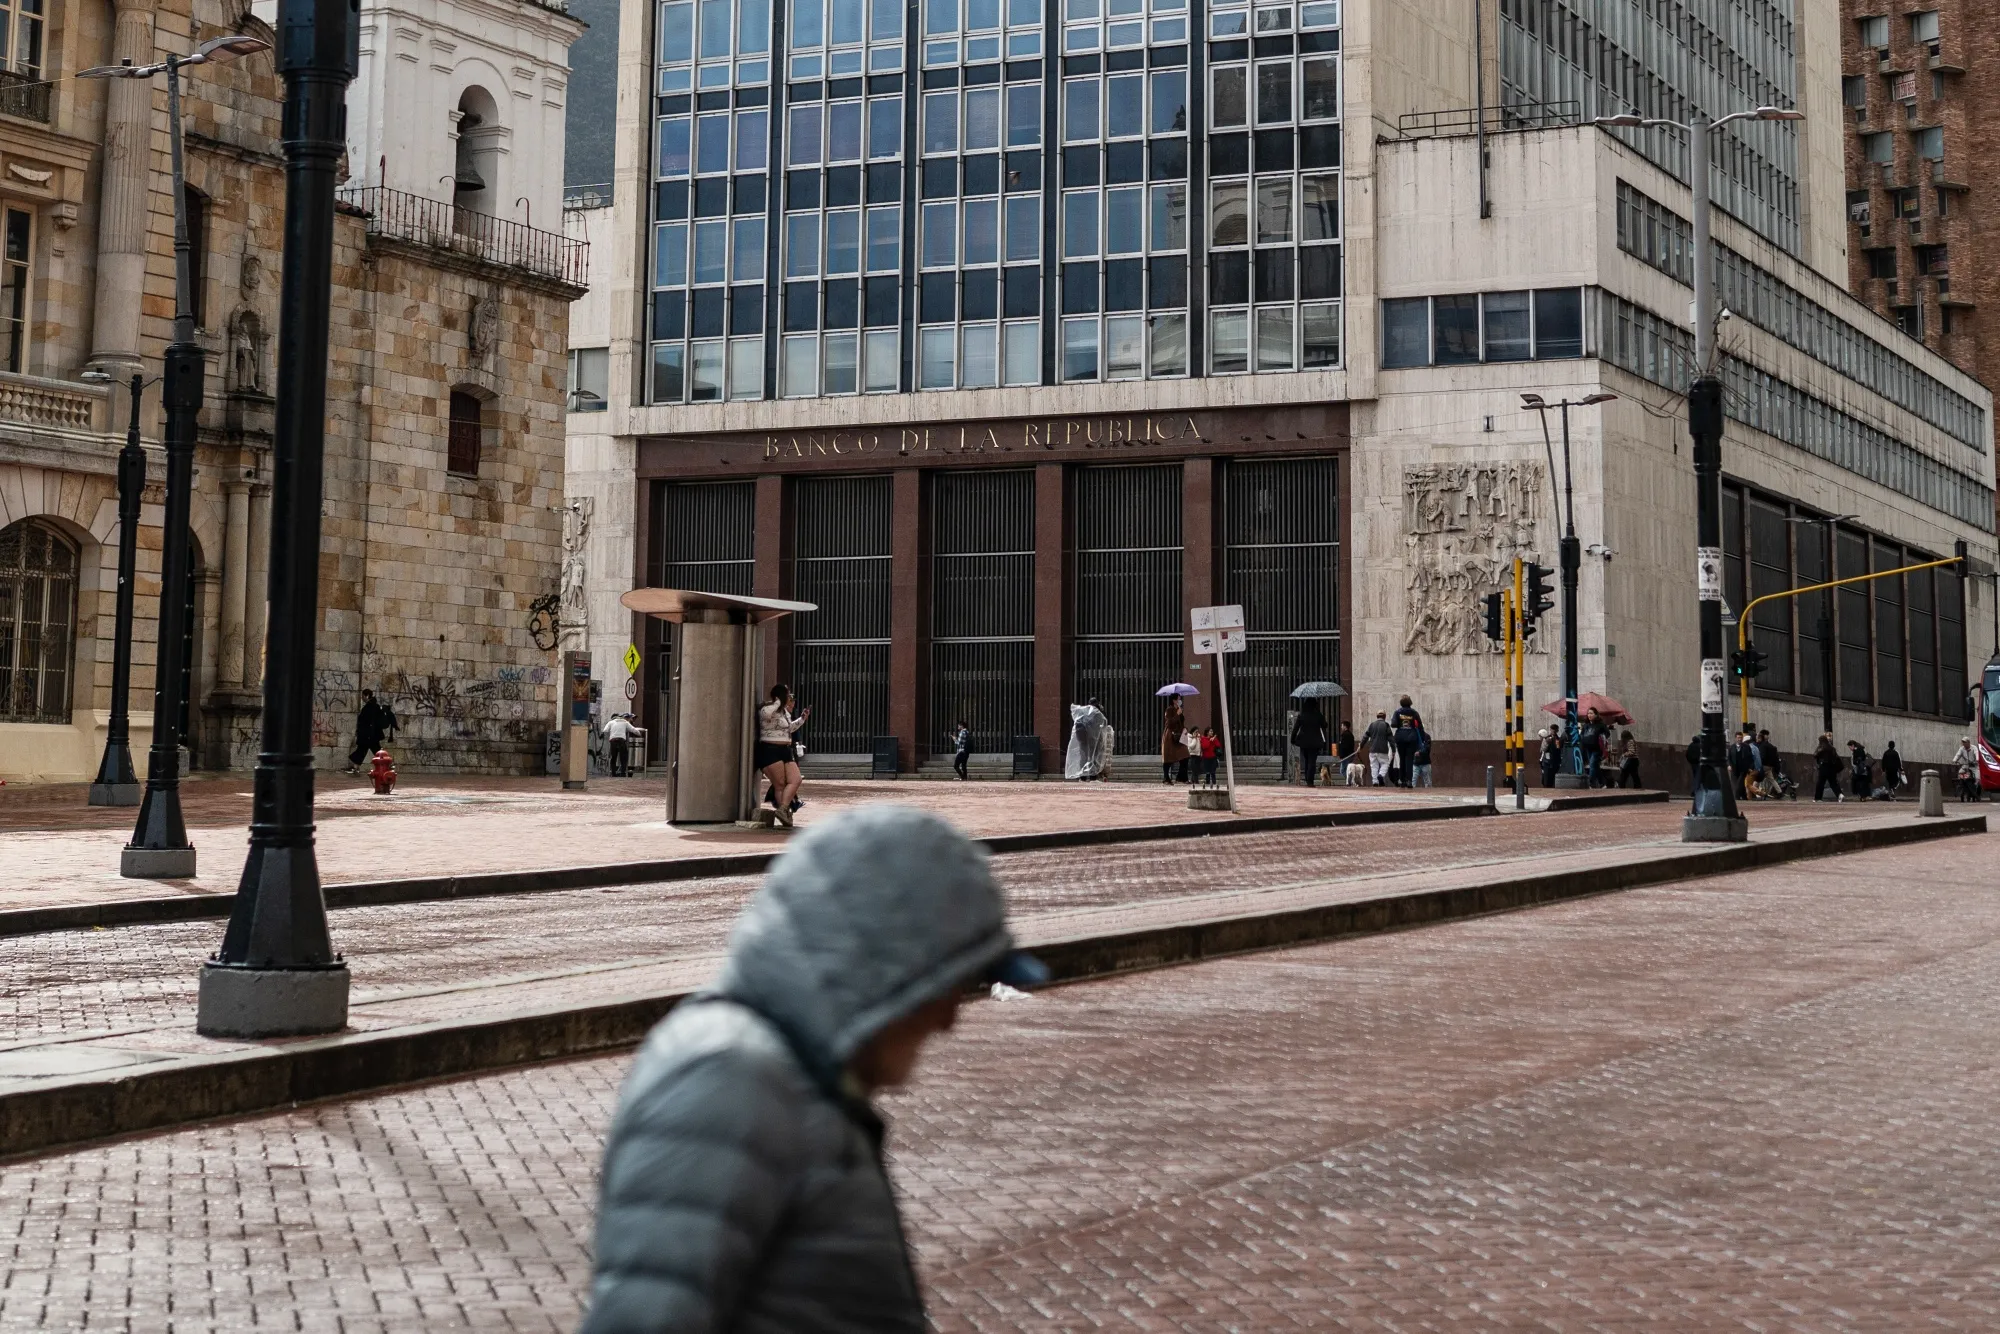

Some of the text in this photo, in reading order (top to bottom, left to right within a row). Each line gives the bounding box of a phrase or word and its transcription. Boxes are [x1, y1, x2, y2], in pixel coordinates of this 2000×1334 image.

[766, 417, 1201, 457] BANCO DE LA REPUBLICA
[628, 683, 636, 694] 10
